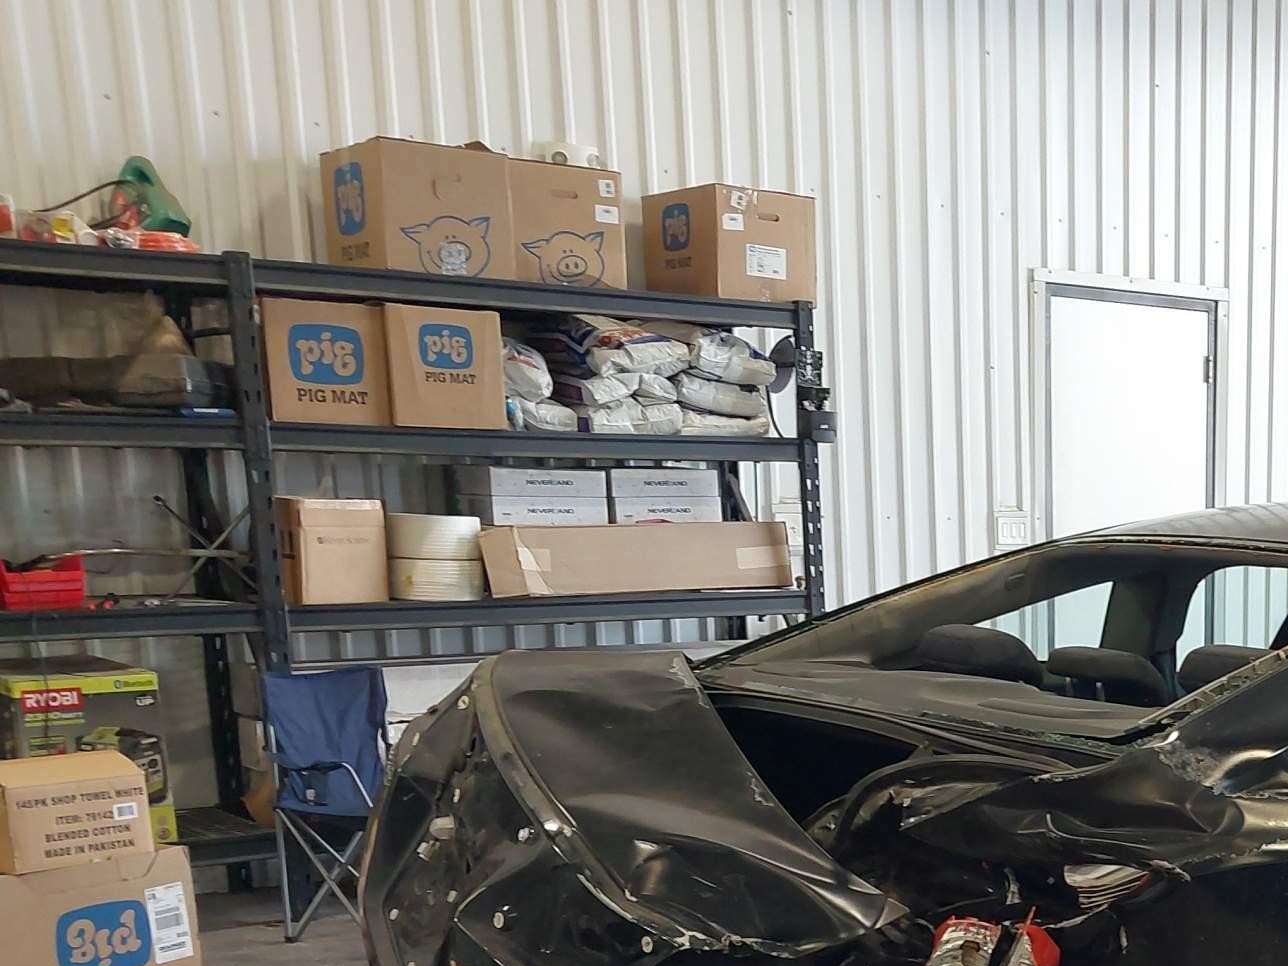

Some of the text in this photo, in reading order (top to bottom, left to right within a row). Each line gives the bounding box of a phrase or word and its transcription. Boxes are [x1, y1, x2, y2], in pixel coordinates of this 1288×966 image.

[296, 332, 356, 377] pig
[424, 329, 467, 364] pig
[425, 371, 476, 384] PIG MAT
[297, 388, 368, 405] PIG MAT
[23, 692, 79, 707] RYOBI
[51, 794, 76, 805] SHOP
[80, 791, 112, 802] TOWEL
[115, 786, 144, 798] WHITE
[45, 824, 130, 843] BLENDED COTTON
[44, 839, 135, 858] MADE IN PAKISTAN
